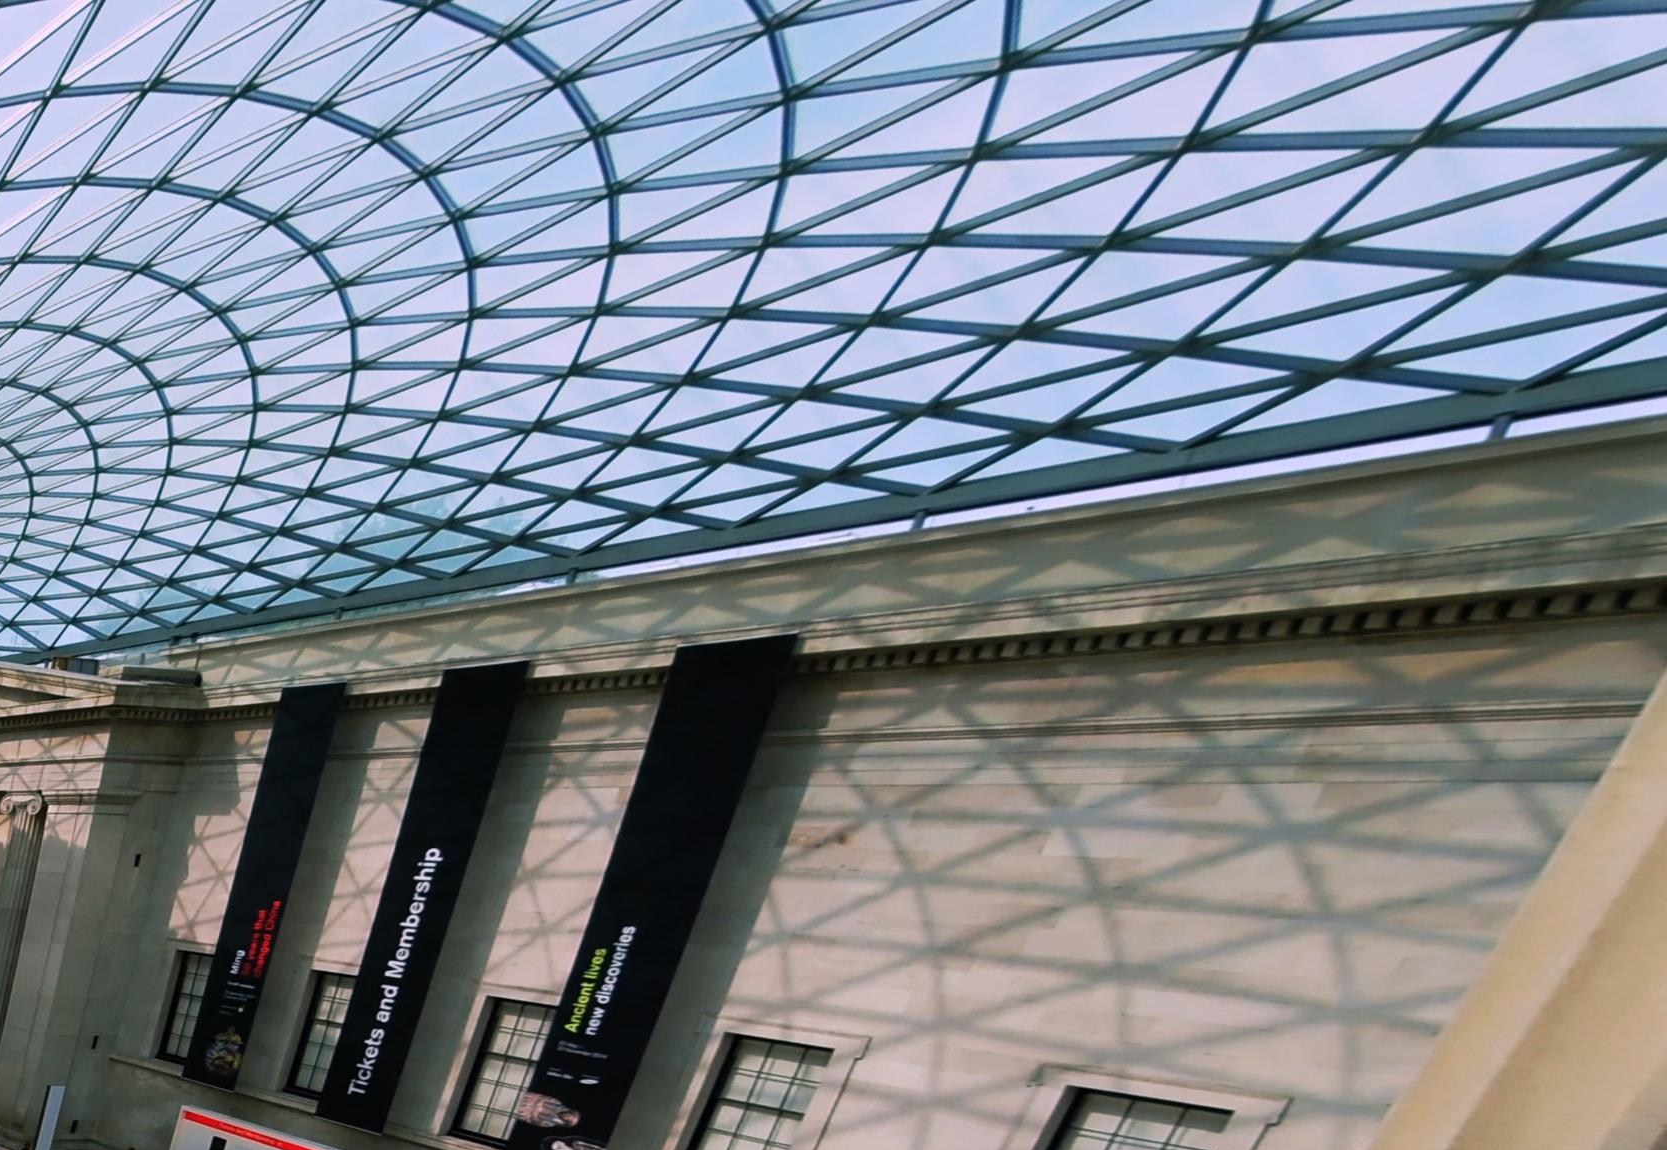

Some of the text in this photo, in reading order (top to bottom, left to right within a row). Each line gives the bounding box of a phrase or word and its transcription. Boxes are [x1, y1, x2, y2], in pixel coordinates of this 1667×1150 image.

[229, 949, 246, 975] Ming
[347, 846, 445, 1095] Tickets and Membership
[563, 982, 596, 1033] Ancient
[581, 948, 608, 980] lives
[585, 925, 637, 1036] new discoveries
